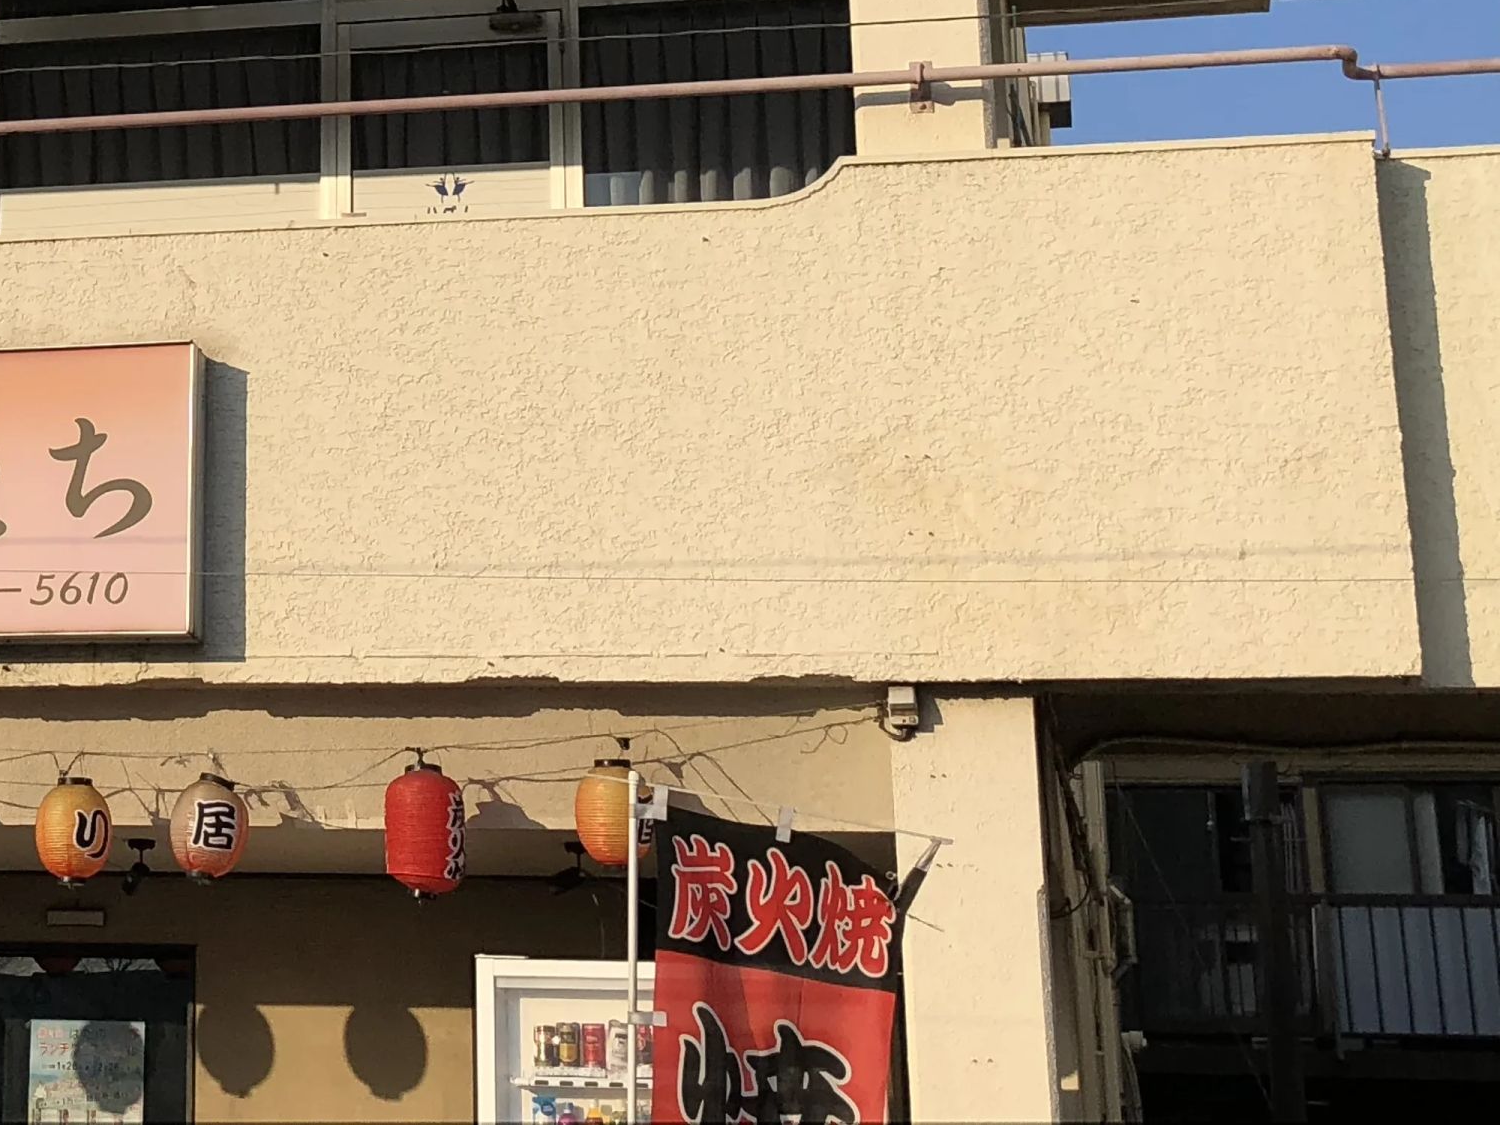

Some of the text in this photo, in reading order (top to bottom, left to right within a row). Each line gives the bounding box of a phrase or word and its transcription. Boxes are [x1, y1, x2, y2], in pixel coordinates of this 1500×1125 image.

[75, 810, 109, 859] り
[192, 801, 237, 850] 居
[668, 835, 897, 978] 炭火焼
